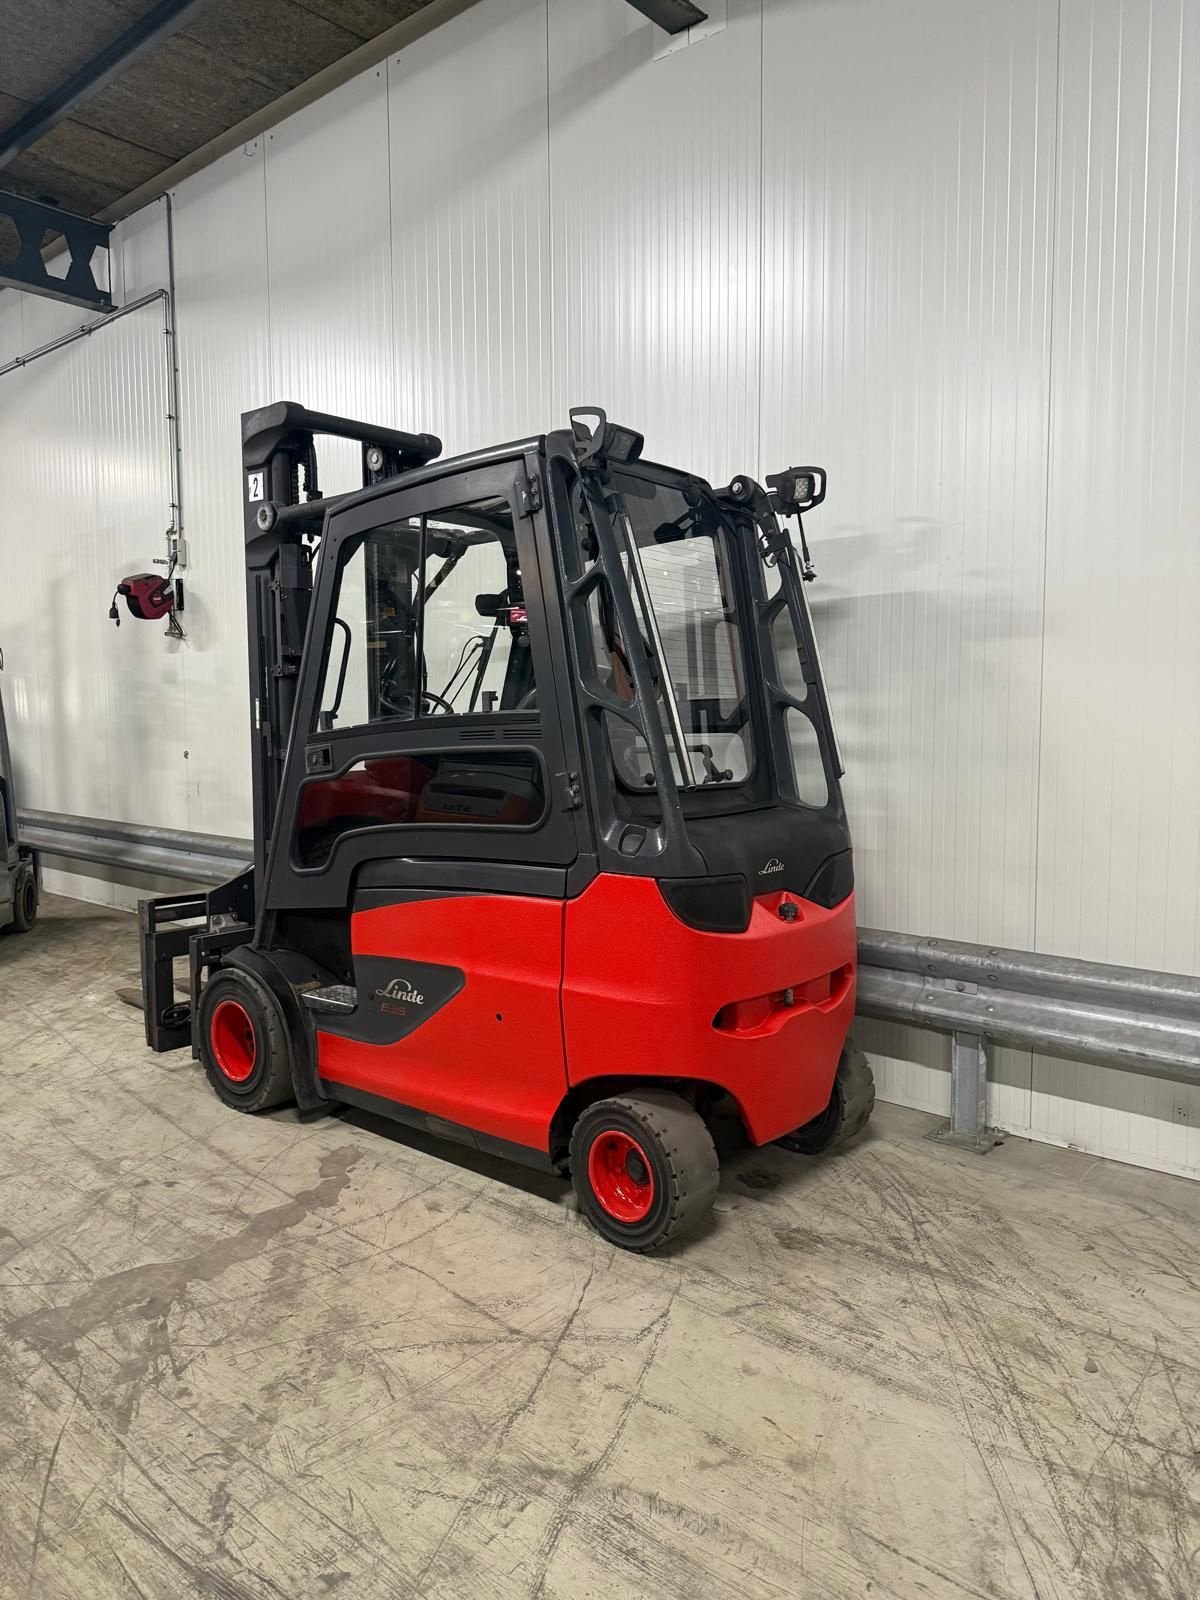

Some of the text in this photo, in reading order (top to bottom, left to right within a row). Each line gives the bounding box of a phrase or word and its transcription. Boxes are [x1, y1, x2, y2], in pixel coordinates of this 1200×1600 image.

[253, 477, 259, 498] 2
[758, 858, 785, 875] Linde
[375, 978, 425, 1005] Linde
